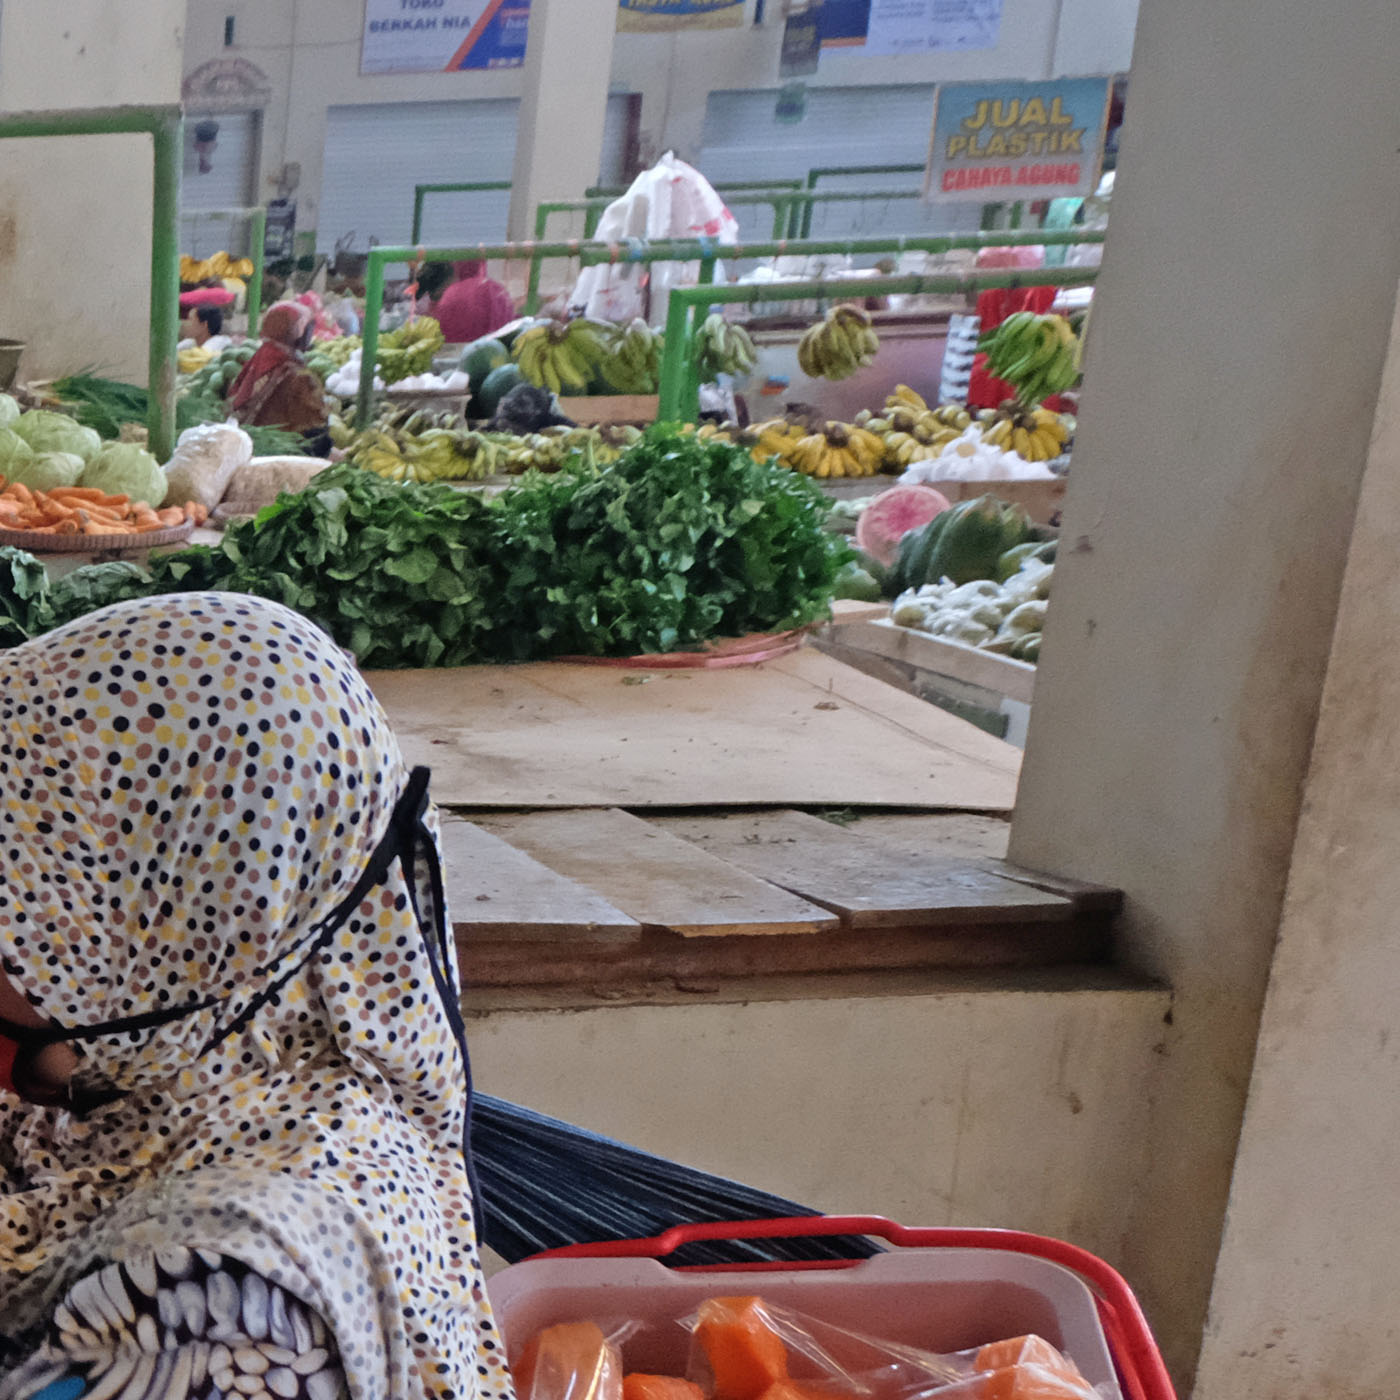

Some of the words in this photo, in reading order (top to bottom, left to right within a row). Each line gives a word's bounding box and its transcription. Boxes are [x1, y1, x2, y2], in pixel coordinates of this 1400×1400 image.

[369, 17, 437, 33] BERKAH
[442, 15, 471, 29] NIA
[963, 97, 1073, 129] JUAL
[946, 128, 1086, 160] PLASTIK
[941, 166, 1012, 192] CAHAYA
[1015, 163, 1080, 186] AGUNG
